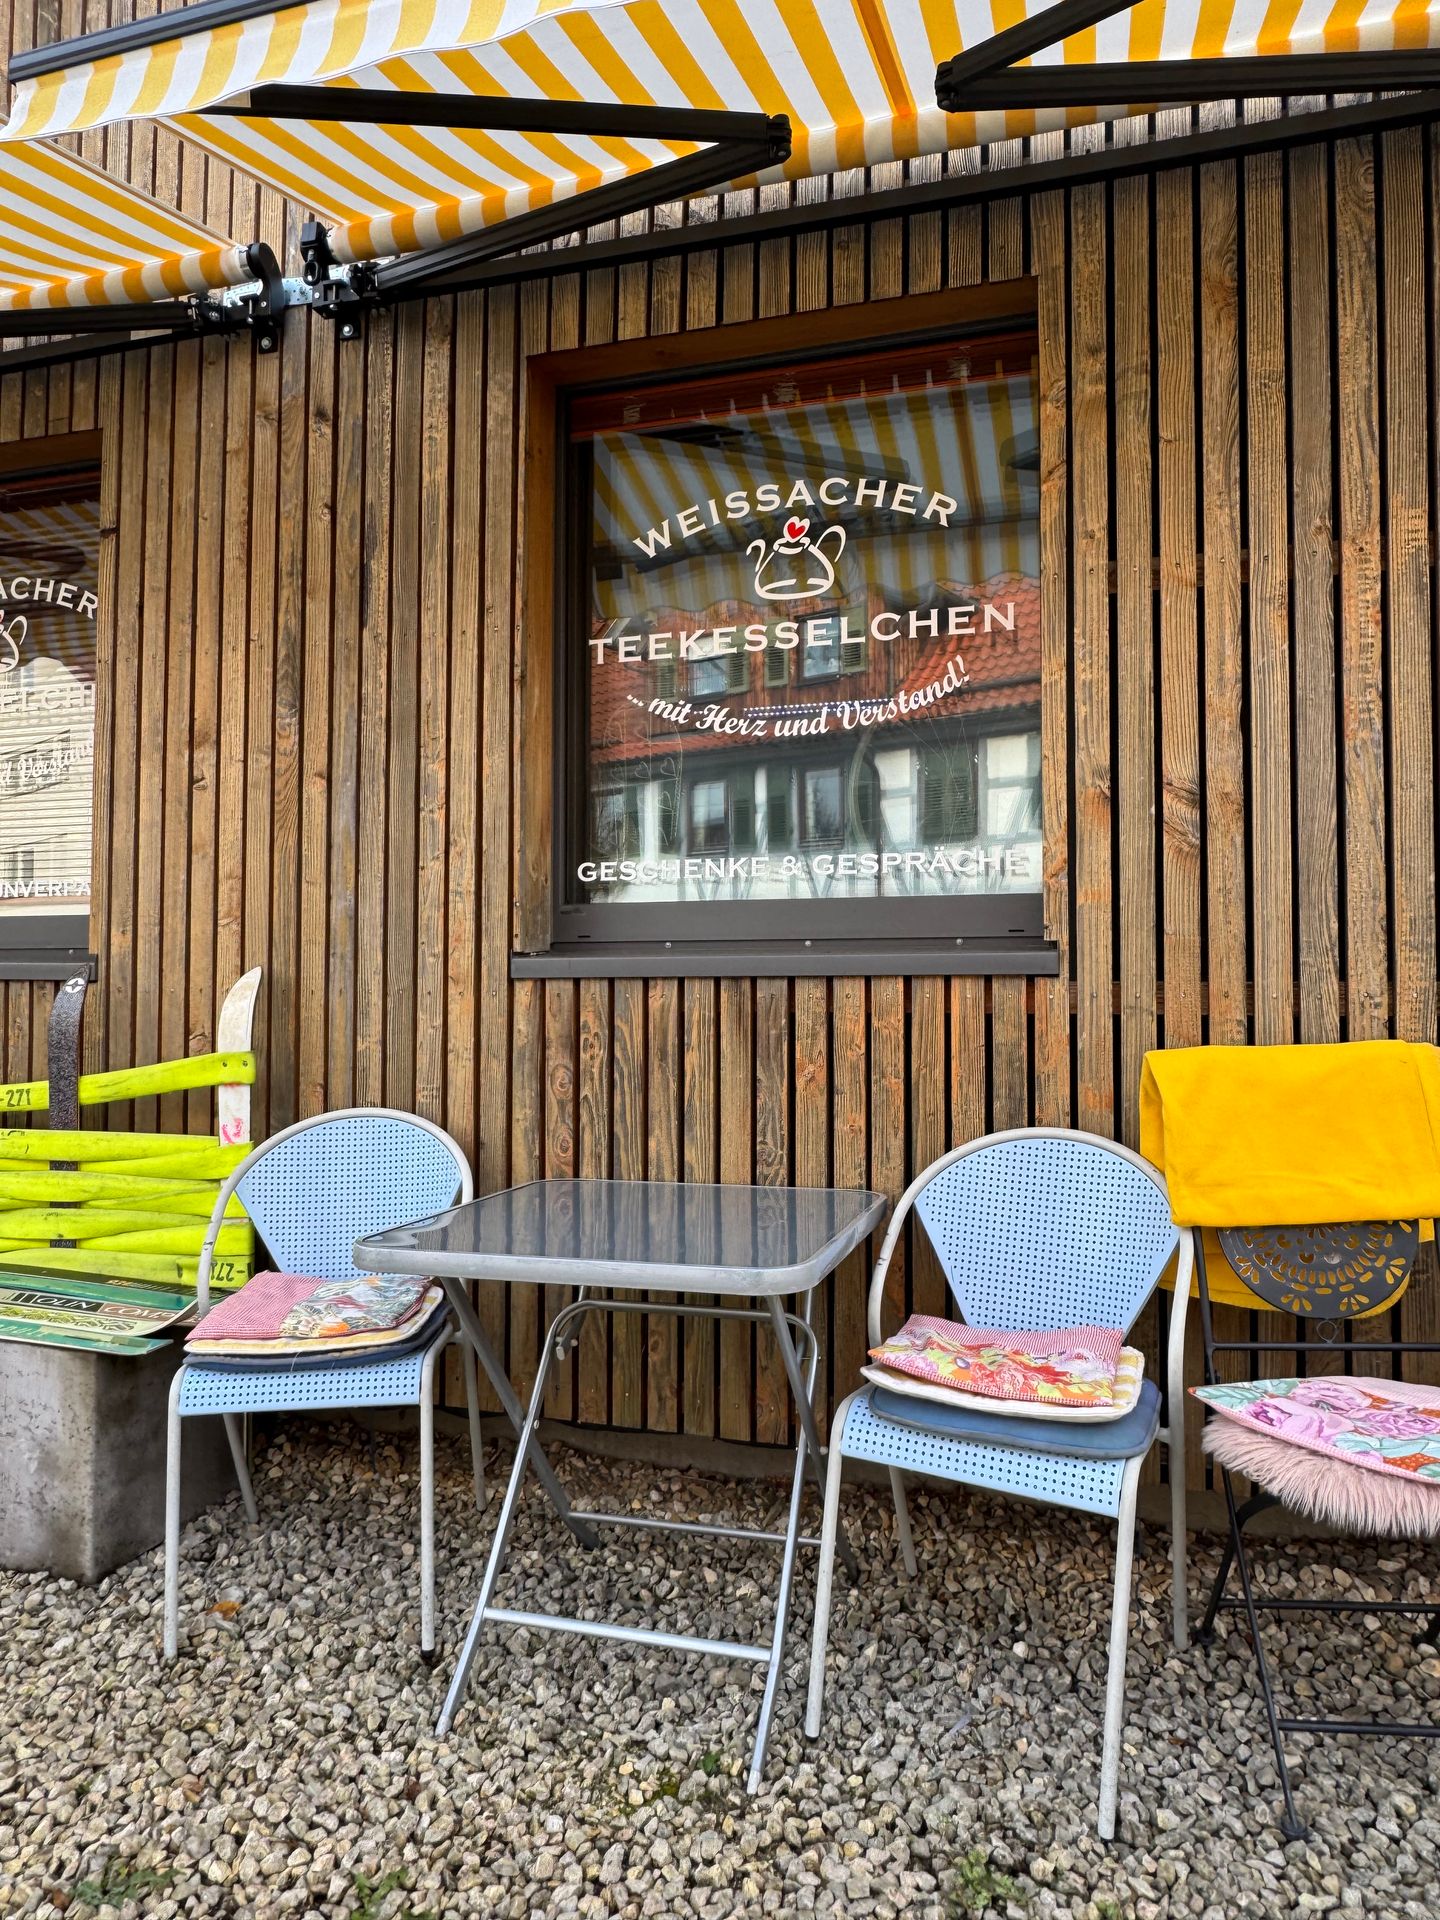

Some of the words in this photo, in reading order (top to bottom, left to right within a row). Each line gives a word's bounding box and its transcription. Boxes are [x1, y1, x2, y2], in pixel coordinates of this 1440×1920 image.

[632, 477, 958, 559] WEISSACHER
[588, 602, 1016, 665] TEEKESSELCHEN
[695, 703, 768, 737] Herz
[774, 705, 830, 737] und
[836, 654, 970, 730] Verstand!
[0, 879, 91, 898] NVERPA
[576, 856, 770, 883] GESCHENKE
[781, 856, 798, 875] &
[812, 846, 1027, 876] GESPRÄCHE
